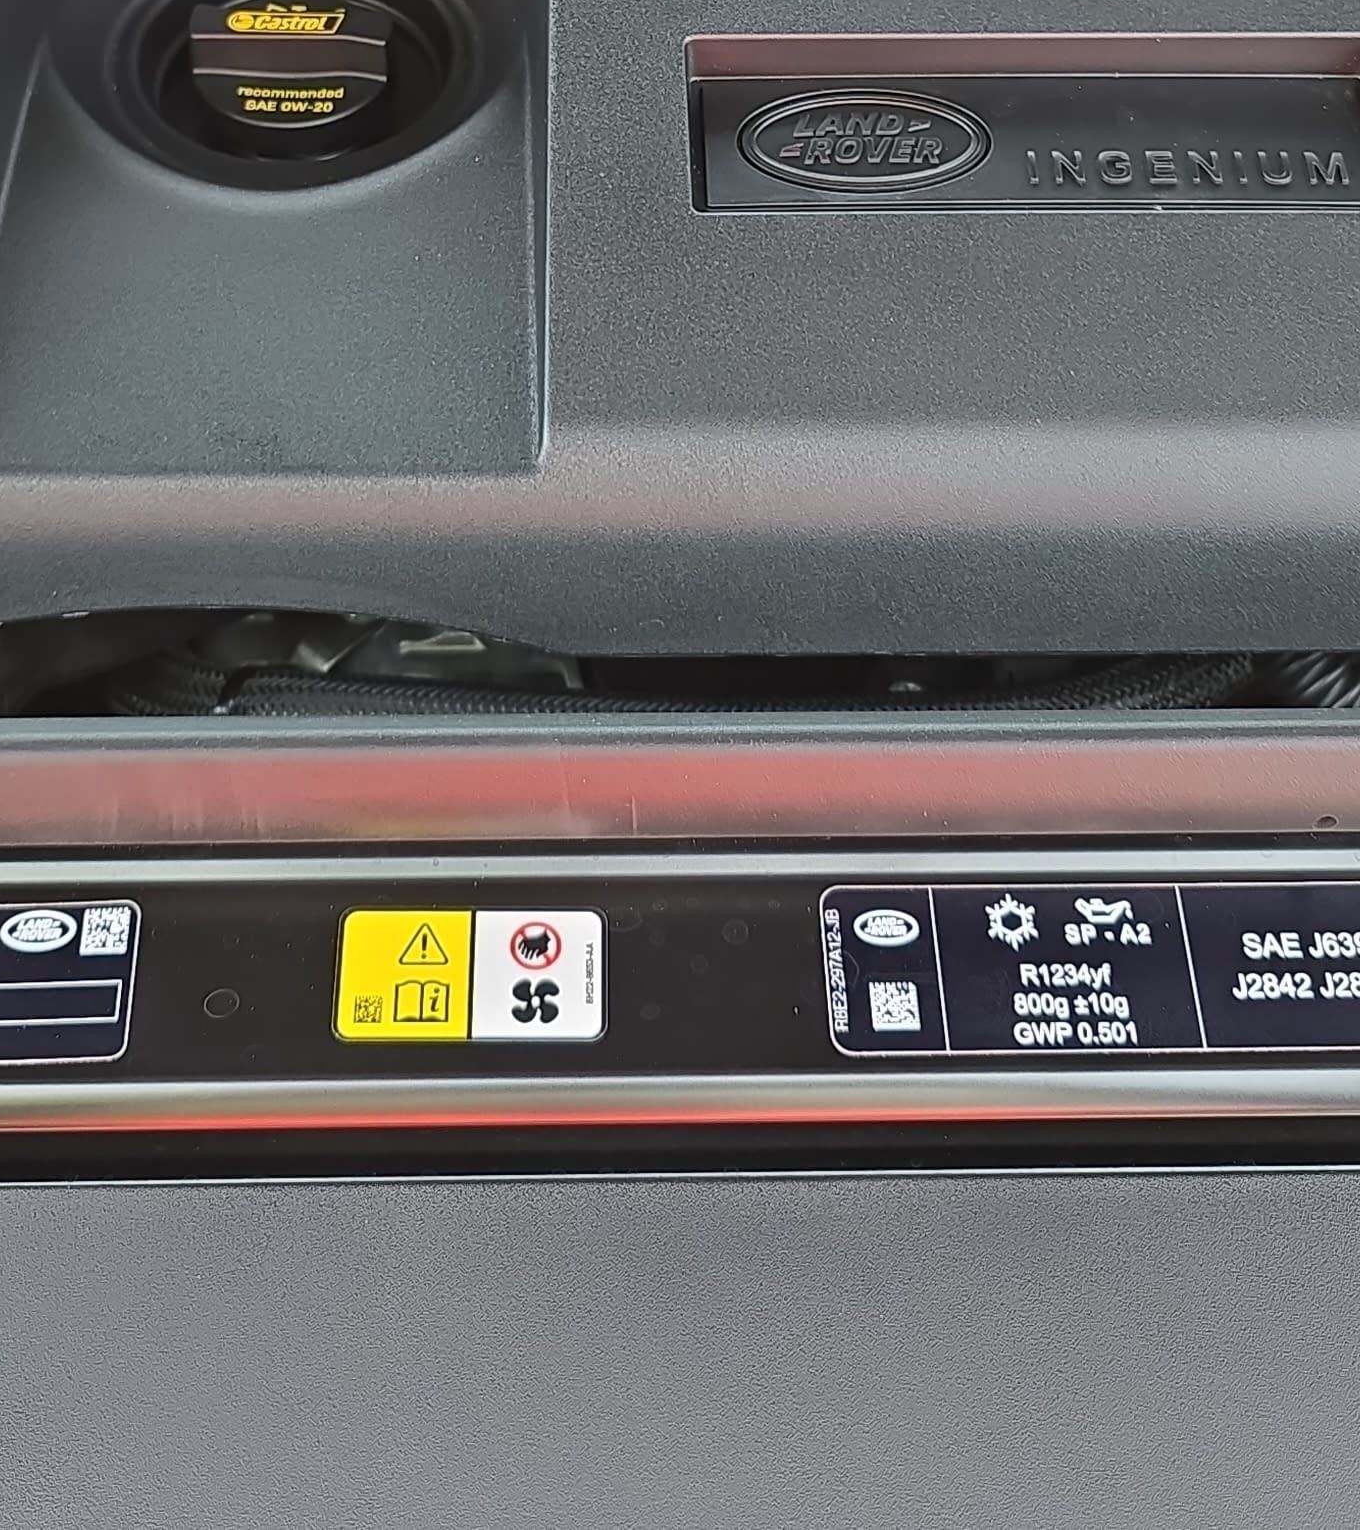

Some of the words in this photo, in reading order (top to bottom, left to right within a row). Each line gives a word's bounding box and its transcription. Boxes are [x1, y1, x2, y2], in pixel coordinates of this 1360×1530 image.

[254, 15, 327, 31] Castrol
[237, 86, 345, 99] recommended
[244, 99, 277, 112] SAE
[792, 112, 905, 138] LAND
[804, 136, 943, 165] ROVER
[1026, 150, 1350, 185] INGENIUM
[1064, 923, 1097, 946] SP
[1120, 922, 1153, 945] A2
[1241, 932, 1304, 959] SAE
[1019, 962, 1112, 990] R1234yf
[1232, 972, 1314, 1000] J2842
[1013, 992, 1070, 1019] 800g
[1073, 992, 1130, 1019] ±10g
[1013, 1021, 1073, 1046] GWP
[1077, 1020, 1138, 1046] 0.501
